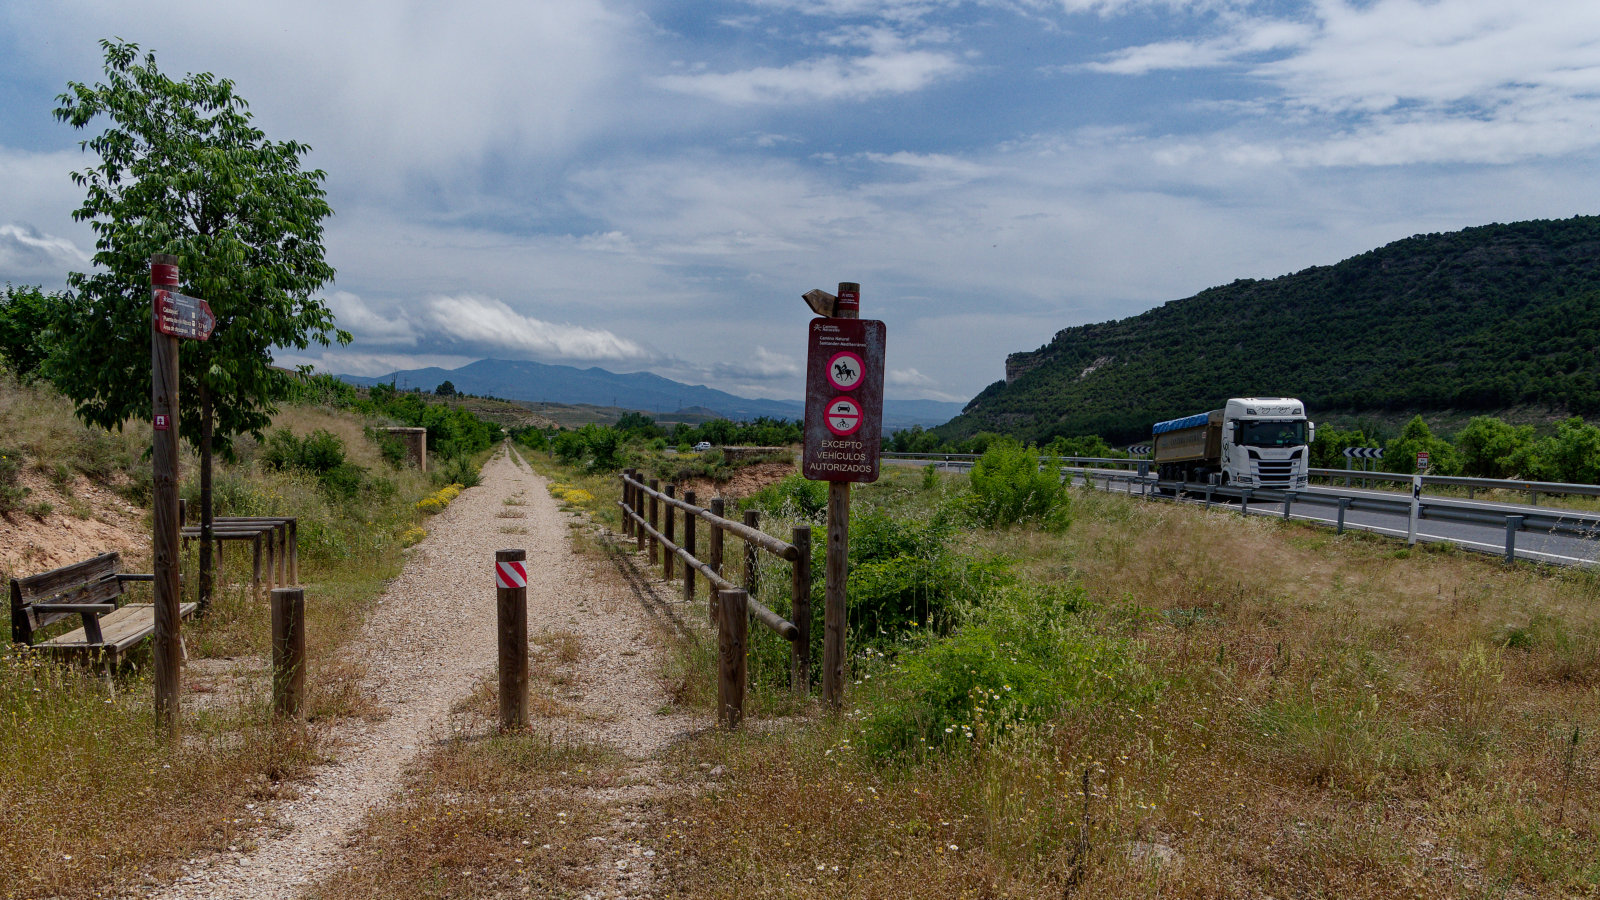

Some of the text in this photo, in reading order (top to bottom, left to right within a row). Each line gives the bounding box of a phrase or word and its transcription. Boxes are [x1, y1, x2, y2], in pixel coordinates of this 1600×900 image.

[821, 440, 863, 450] EXCEPTO
[816, 451, 866, 461] VEHÍCULOS
[809, 462, 872, 473] AUTORIZADOS
